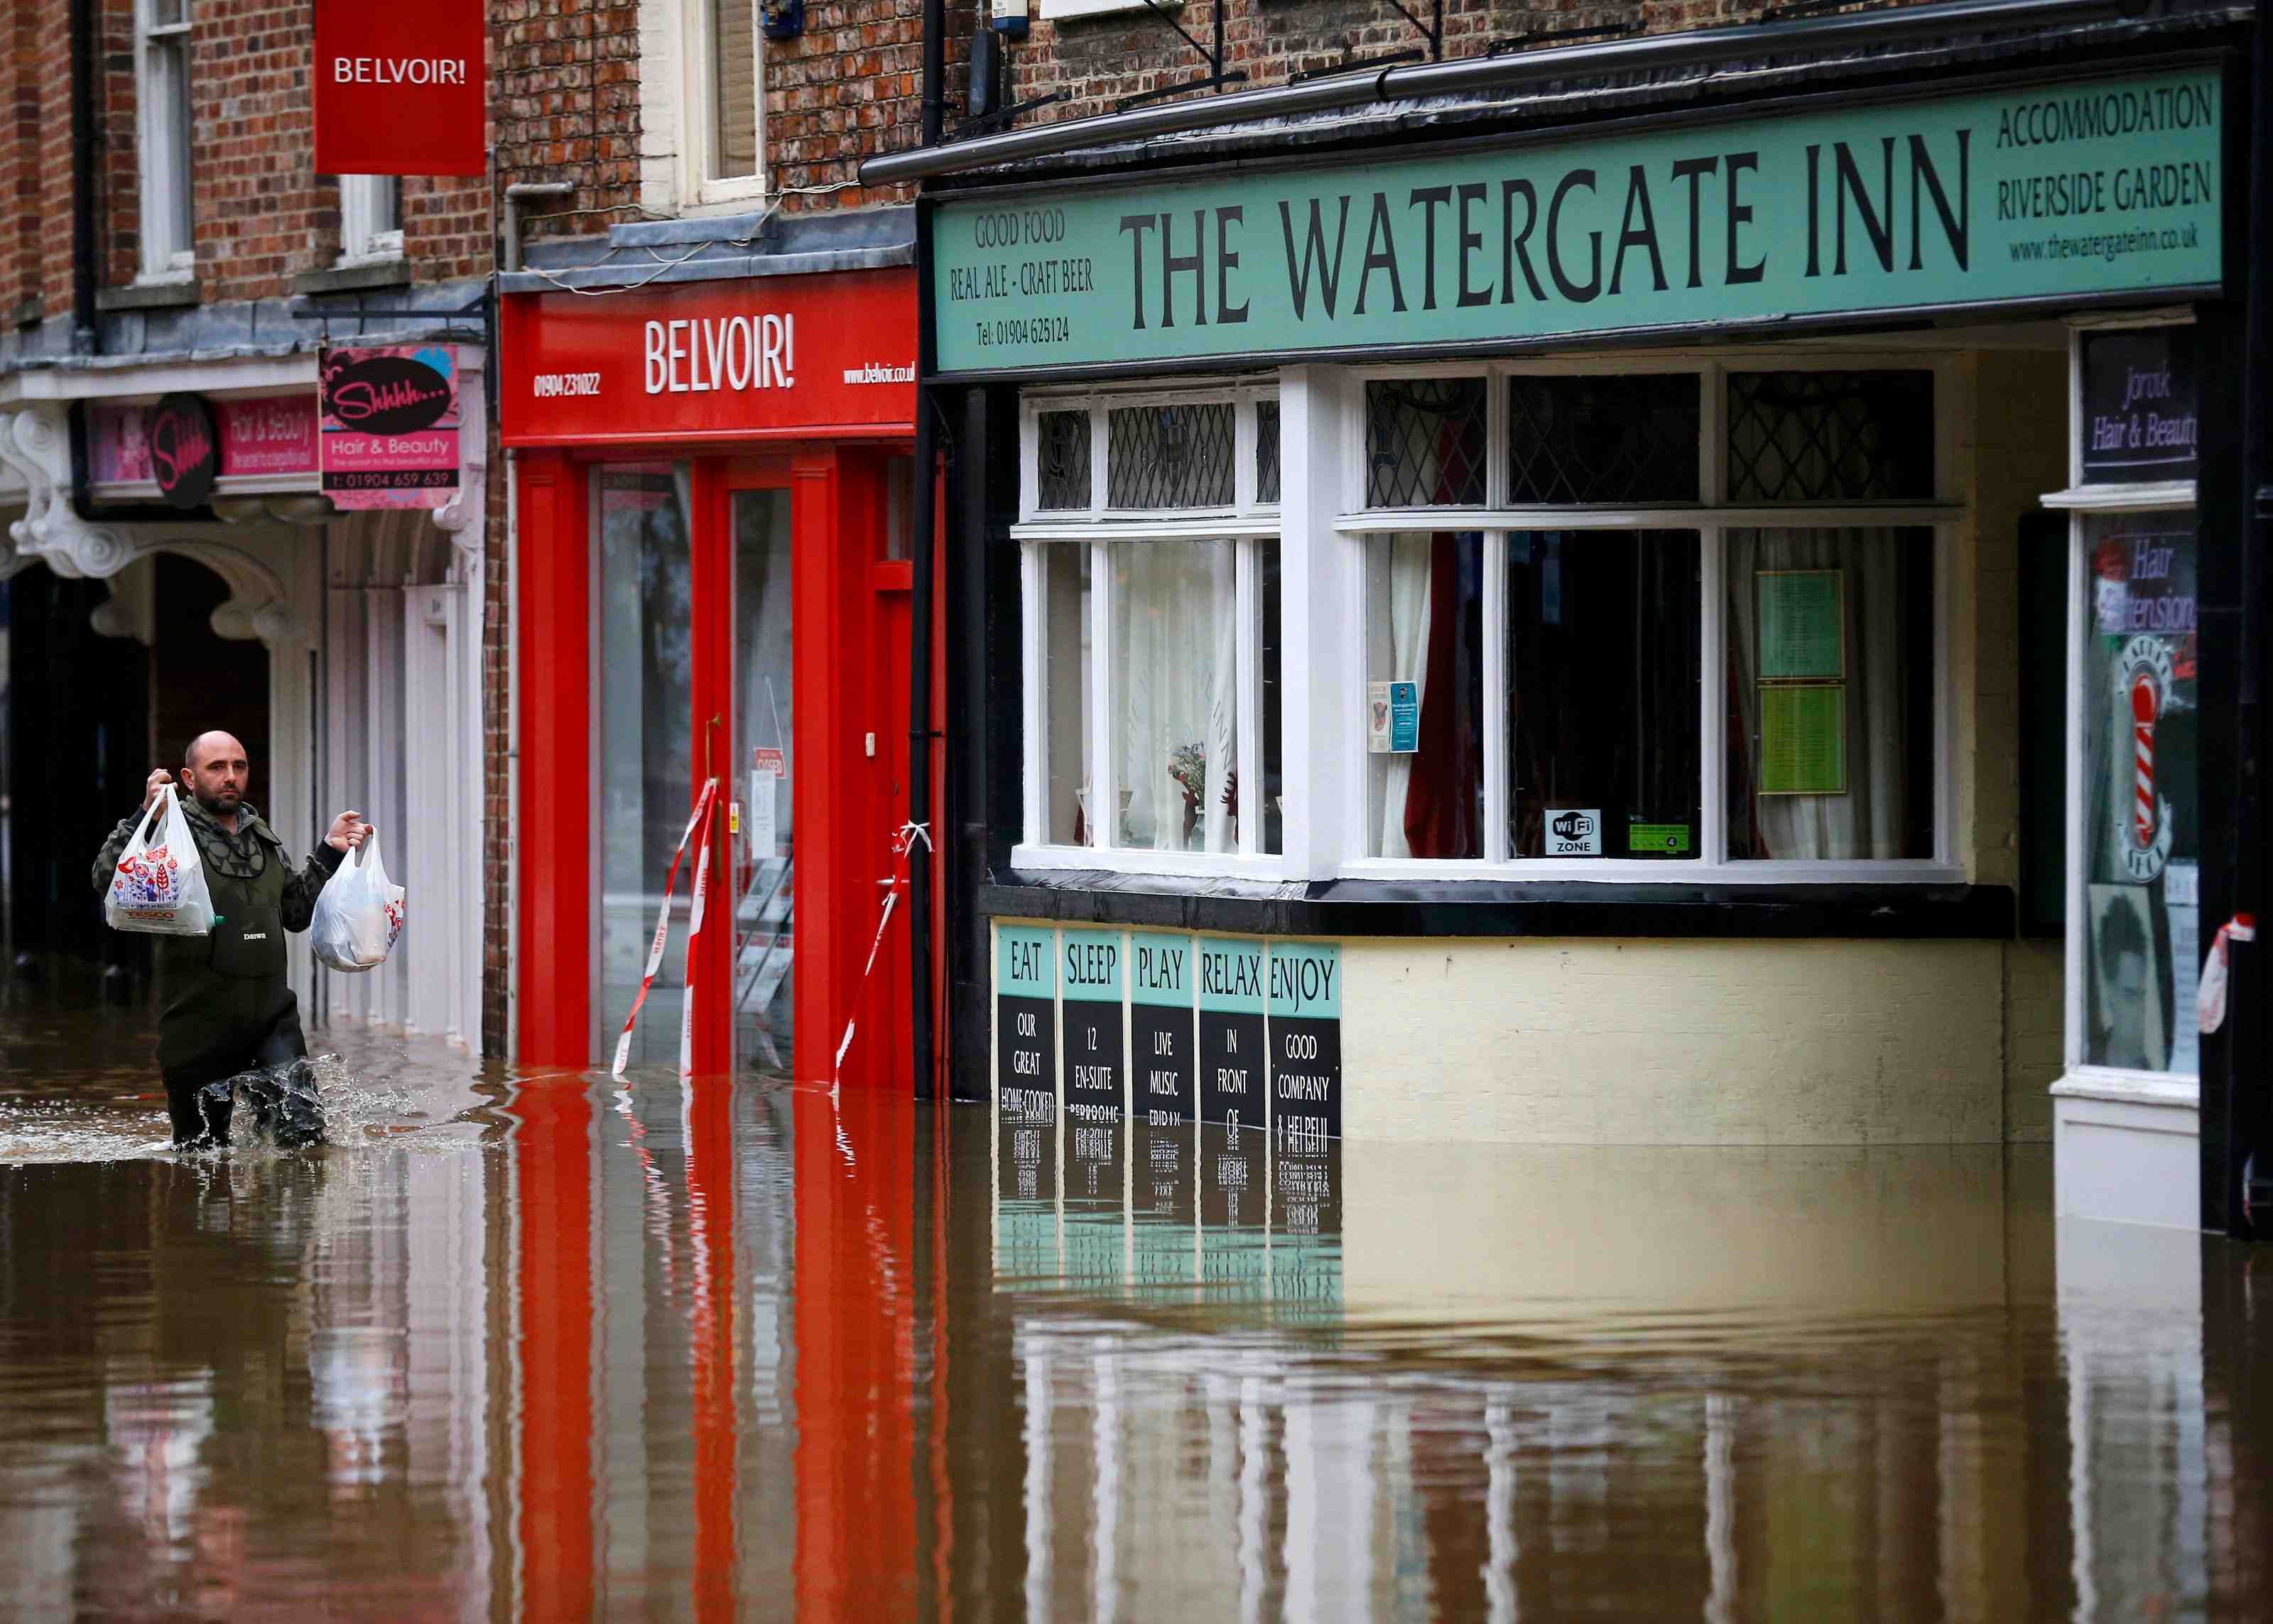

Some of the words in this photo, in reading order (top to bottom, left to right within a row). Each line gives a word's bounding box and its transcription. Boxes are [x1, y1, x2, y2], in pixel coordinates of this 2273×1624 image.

[334, 57, 465, 85] BELVOIR!
[1997, 82, 2213, 148] ACCOMMODATION
[1999, 171, 2105, 220] RIVERSIDE
[2115, 160, 2211, 211] GARDEN
[975, 212, 1019, 249] GOOD
[1024, 207, 1065, 244] FOOD
[1119, 205, 1249, 329] THE
[1278, 151, 1768, 322] WATERGATE
[1805, 129, 1971, 277] INN
[2009, 223, 2198, 262] www.thewatergateinn.co.uk
[950, 266, 980, 301] REAL
[984, 264, 1008, 298] ALE
[1021, 260, 1058, 295] CRAFT
[1062, 258, 1094, 293] BEER
[977, 322, 994, 346] Tel:
[997, 320, 1029, 345] 01904
[1031, 317, 1069, 344] 625124
[645, 312, 794, 396] BELVOIR!
[2093, 415, 2126, 450] Hair
[2128, 413, 2142, 449] &
[331, 439, 366, 454] Hair
[370, 439, 384, 454] &
[389, 438, 450, 455] Beauty
[347, 474, 389, 487] 01904
[394, 474, 419, 486] 659
[423, 472, 449, 486] 639
[2132, 538, 2174, 580] Hair
[1556, 842, 1591, 852] ZONE
[1011, 941, 1041, 981] EAT
[1068, 943, 1116, 985] SLEEP
[1139, 947, 1183, 990] PLAY
[1203, 953, 1262, 997] RELAX
[1270, 957, 1335, 1013] ENJOY
[1017, 1013, 1036, 1037] OUR
[1087, 1027, 1097, 1050] 12
[1154, 1031, 1173, 1056] LIVE
[1227, 1028, 1237, 1054] IN
[1286, 1034, 1317, 1059] GOOD
[1014, 1050, 1041, 1076] GREAT
[1075, 1065, 1112, 1090] EN-SUITE
[1150, 1070, 1178, 1096] MUSIC
[1217, 1068, 1247, 1094] FRONT
[1278, 1074, 1330, 1101] COMPANY
